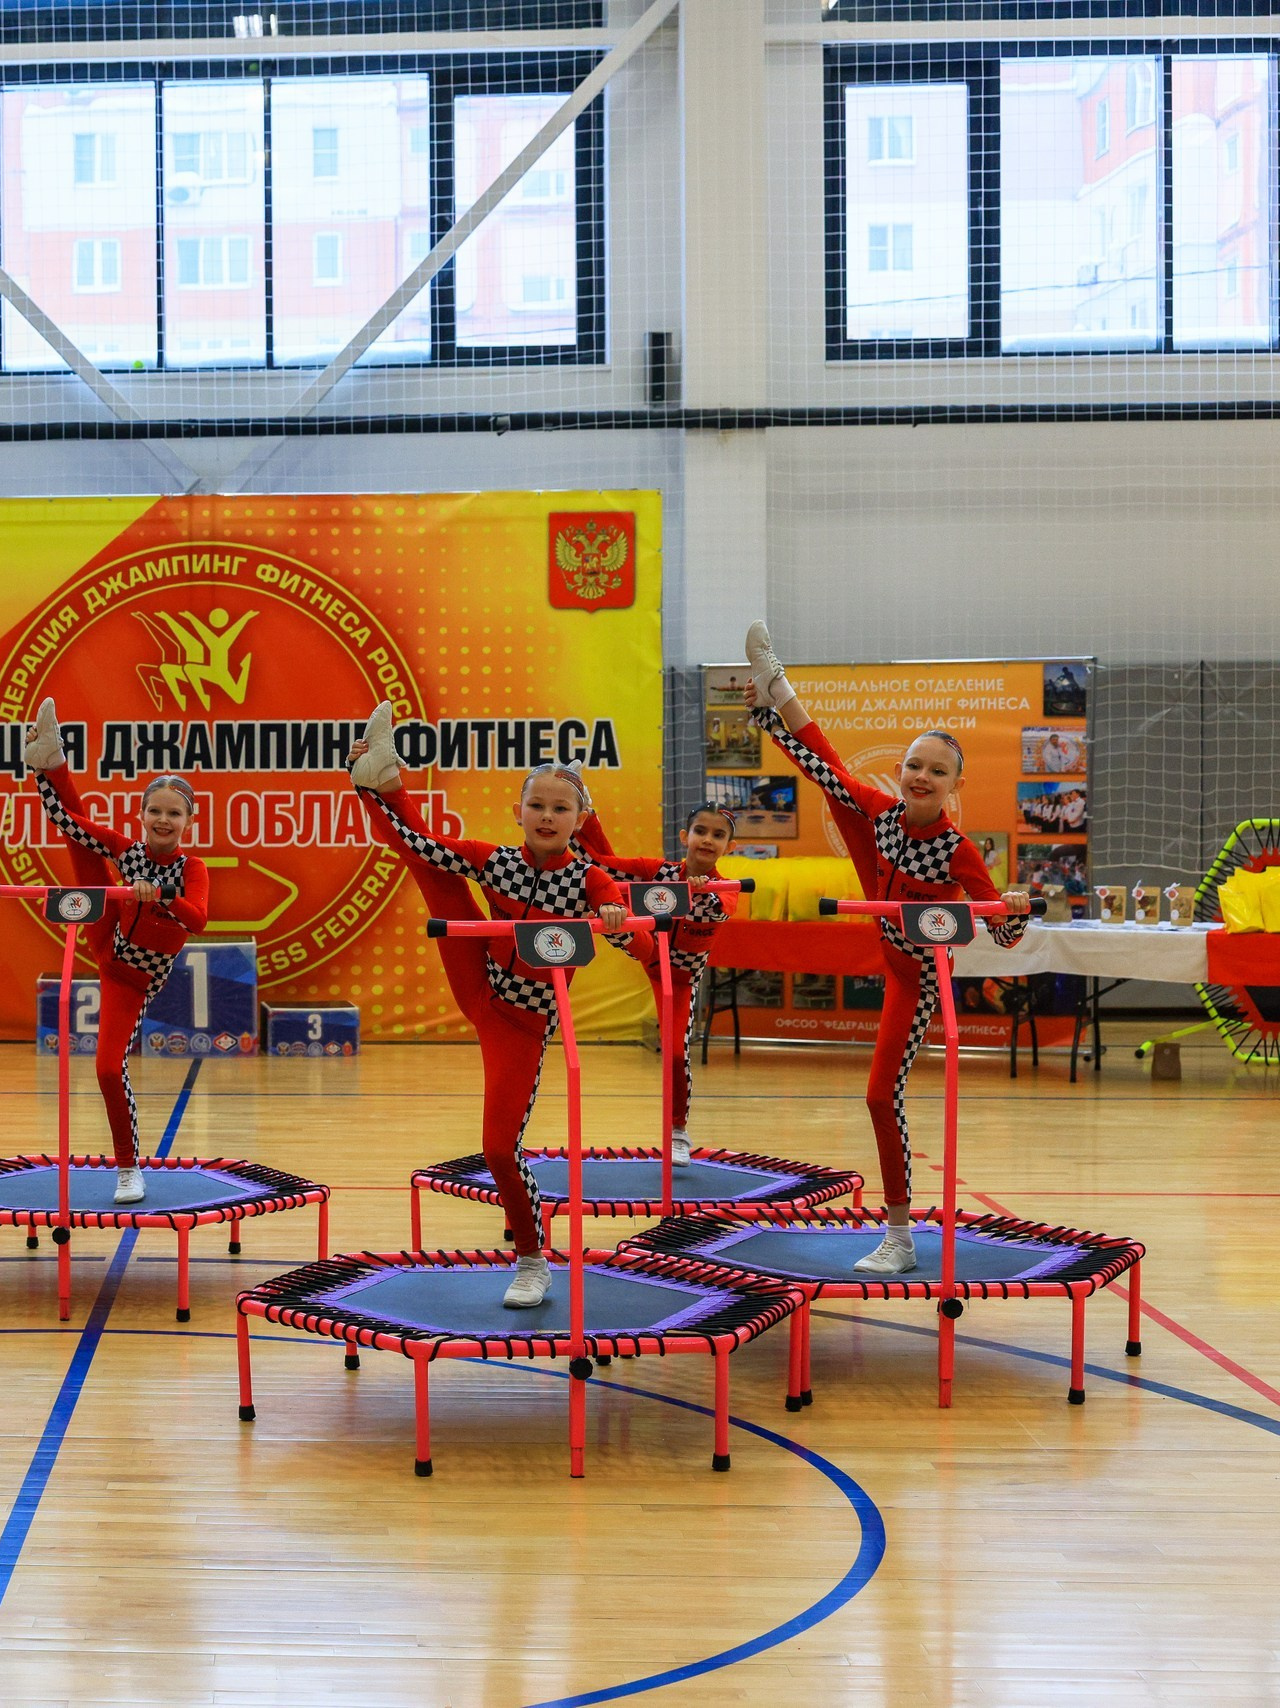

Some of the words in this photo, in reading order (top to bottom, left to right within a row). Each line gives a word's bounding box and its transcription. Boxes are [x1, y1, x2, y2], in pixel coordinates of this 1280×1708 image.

[82, 553, 248, 614] ДЖАМПИНГ
[255, 563, 372, 649] ФИТНЕСА
[366, 646, 415, 724] РОСС
[860, 697, 952, 713] ДЖАМПИНГ
[957, 697, 1030, 711] ФИТНЕСА
[915, 678, 1005, 693] ОТДЕЛЕНИЕ
[393, 718, 622, 772] ФИТНЕСА
[902, 716, 977, 730] ОБЛАСТИ
[227, 790, 465, 848] ОБЛАЬ
[310, 845, 401, 949] FEDERAT
[76, 986, 101, 1033] 2
[185, 951, 209, 1028] 1
[307, 1013, 322, 1040] 3
